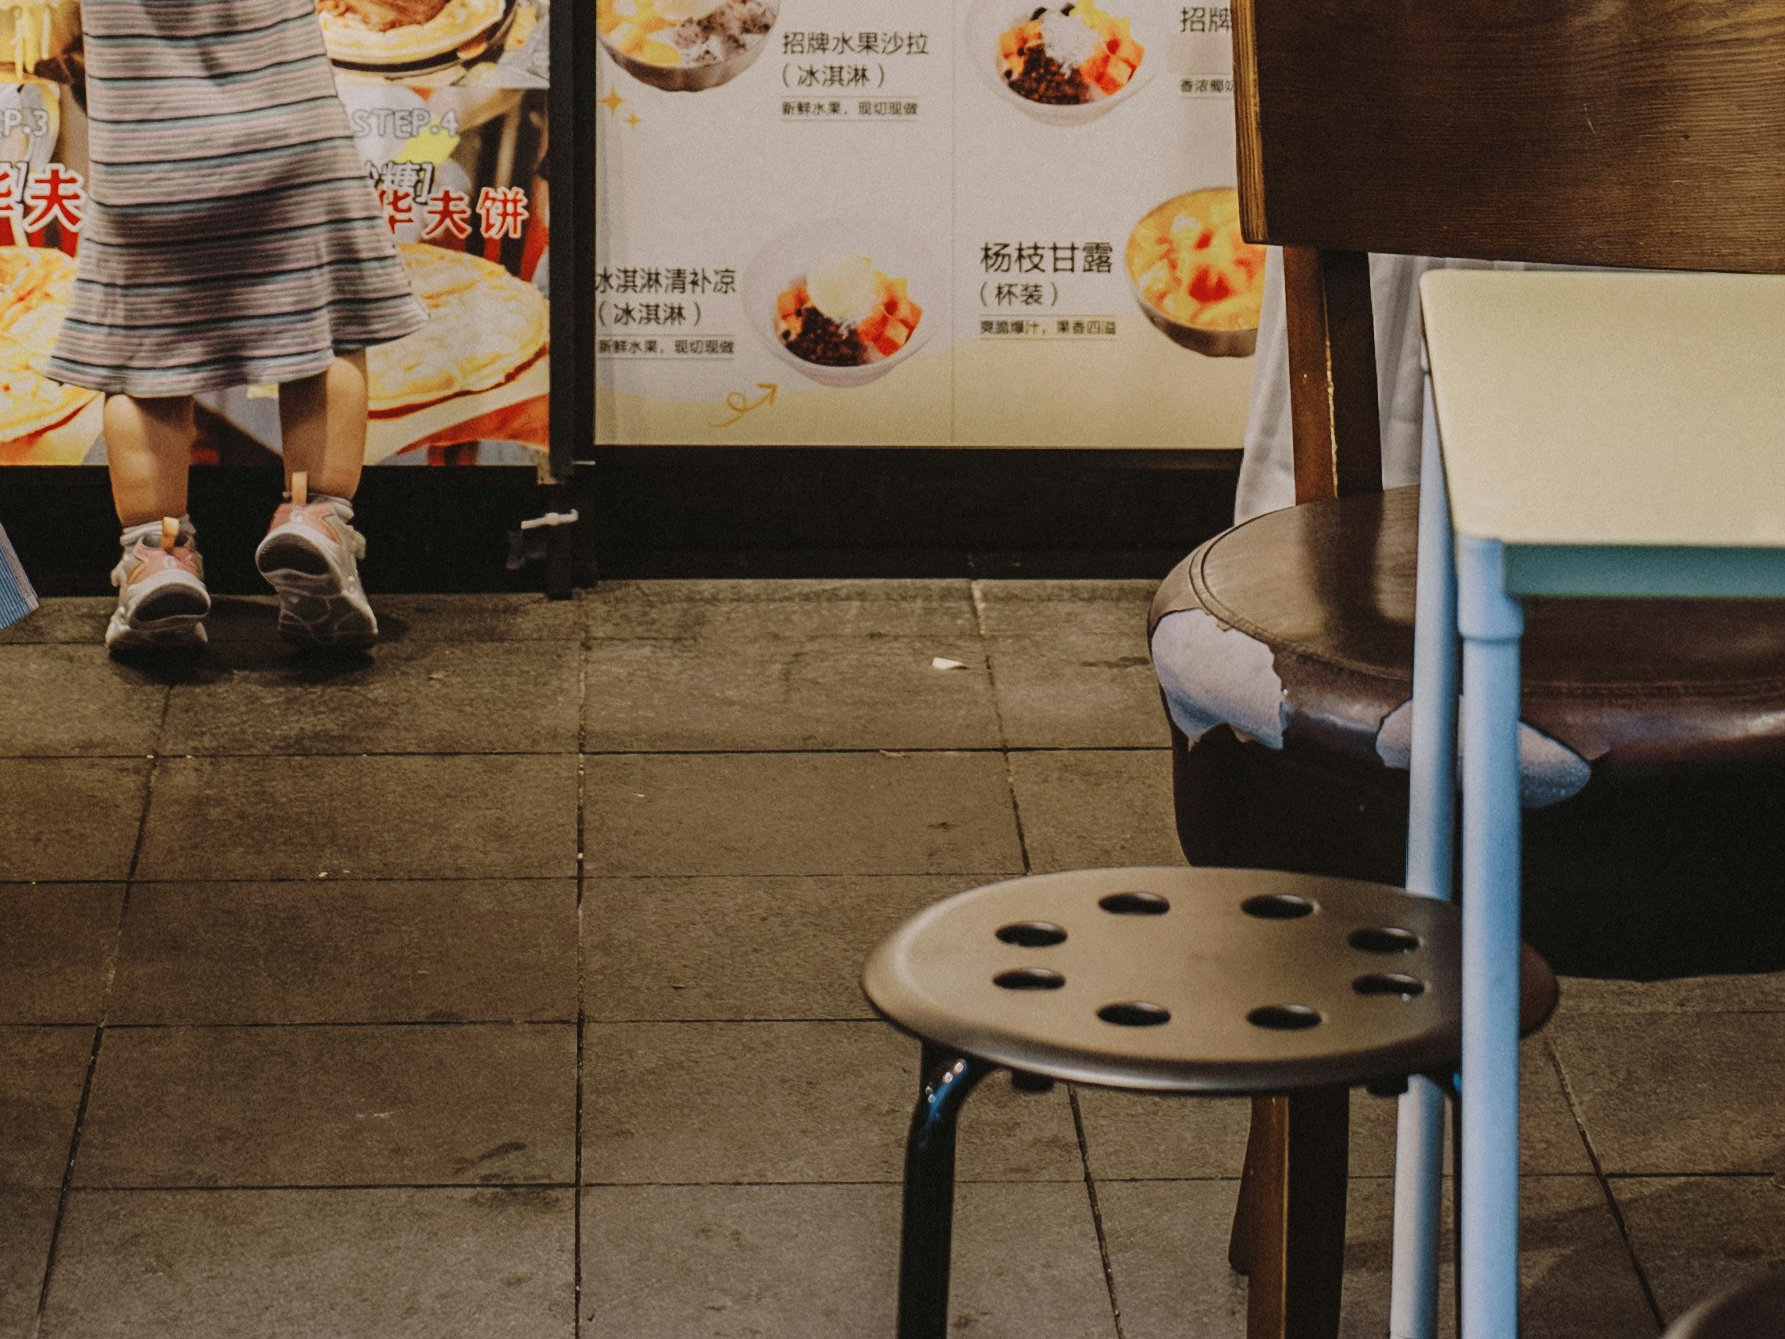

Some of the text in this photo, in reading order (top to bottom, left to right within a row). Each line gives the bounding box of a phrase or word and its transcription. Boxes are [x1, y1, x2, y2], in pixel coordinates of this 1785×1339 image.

[1180, 6, 1232, 33] 招牌
[781, 30, 930, 57] 招牌水果沙拉
[351, 107, 460, 140] STEP.4
[979, 242, 1114, 275] 杨枝甘露
[979, 282, 1059, 307] （杯装）
